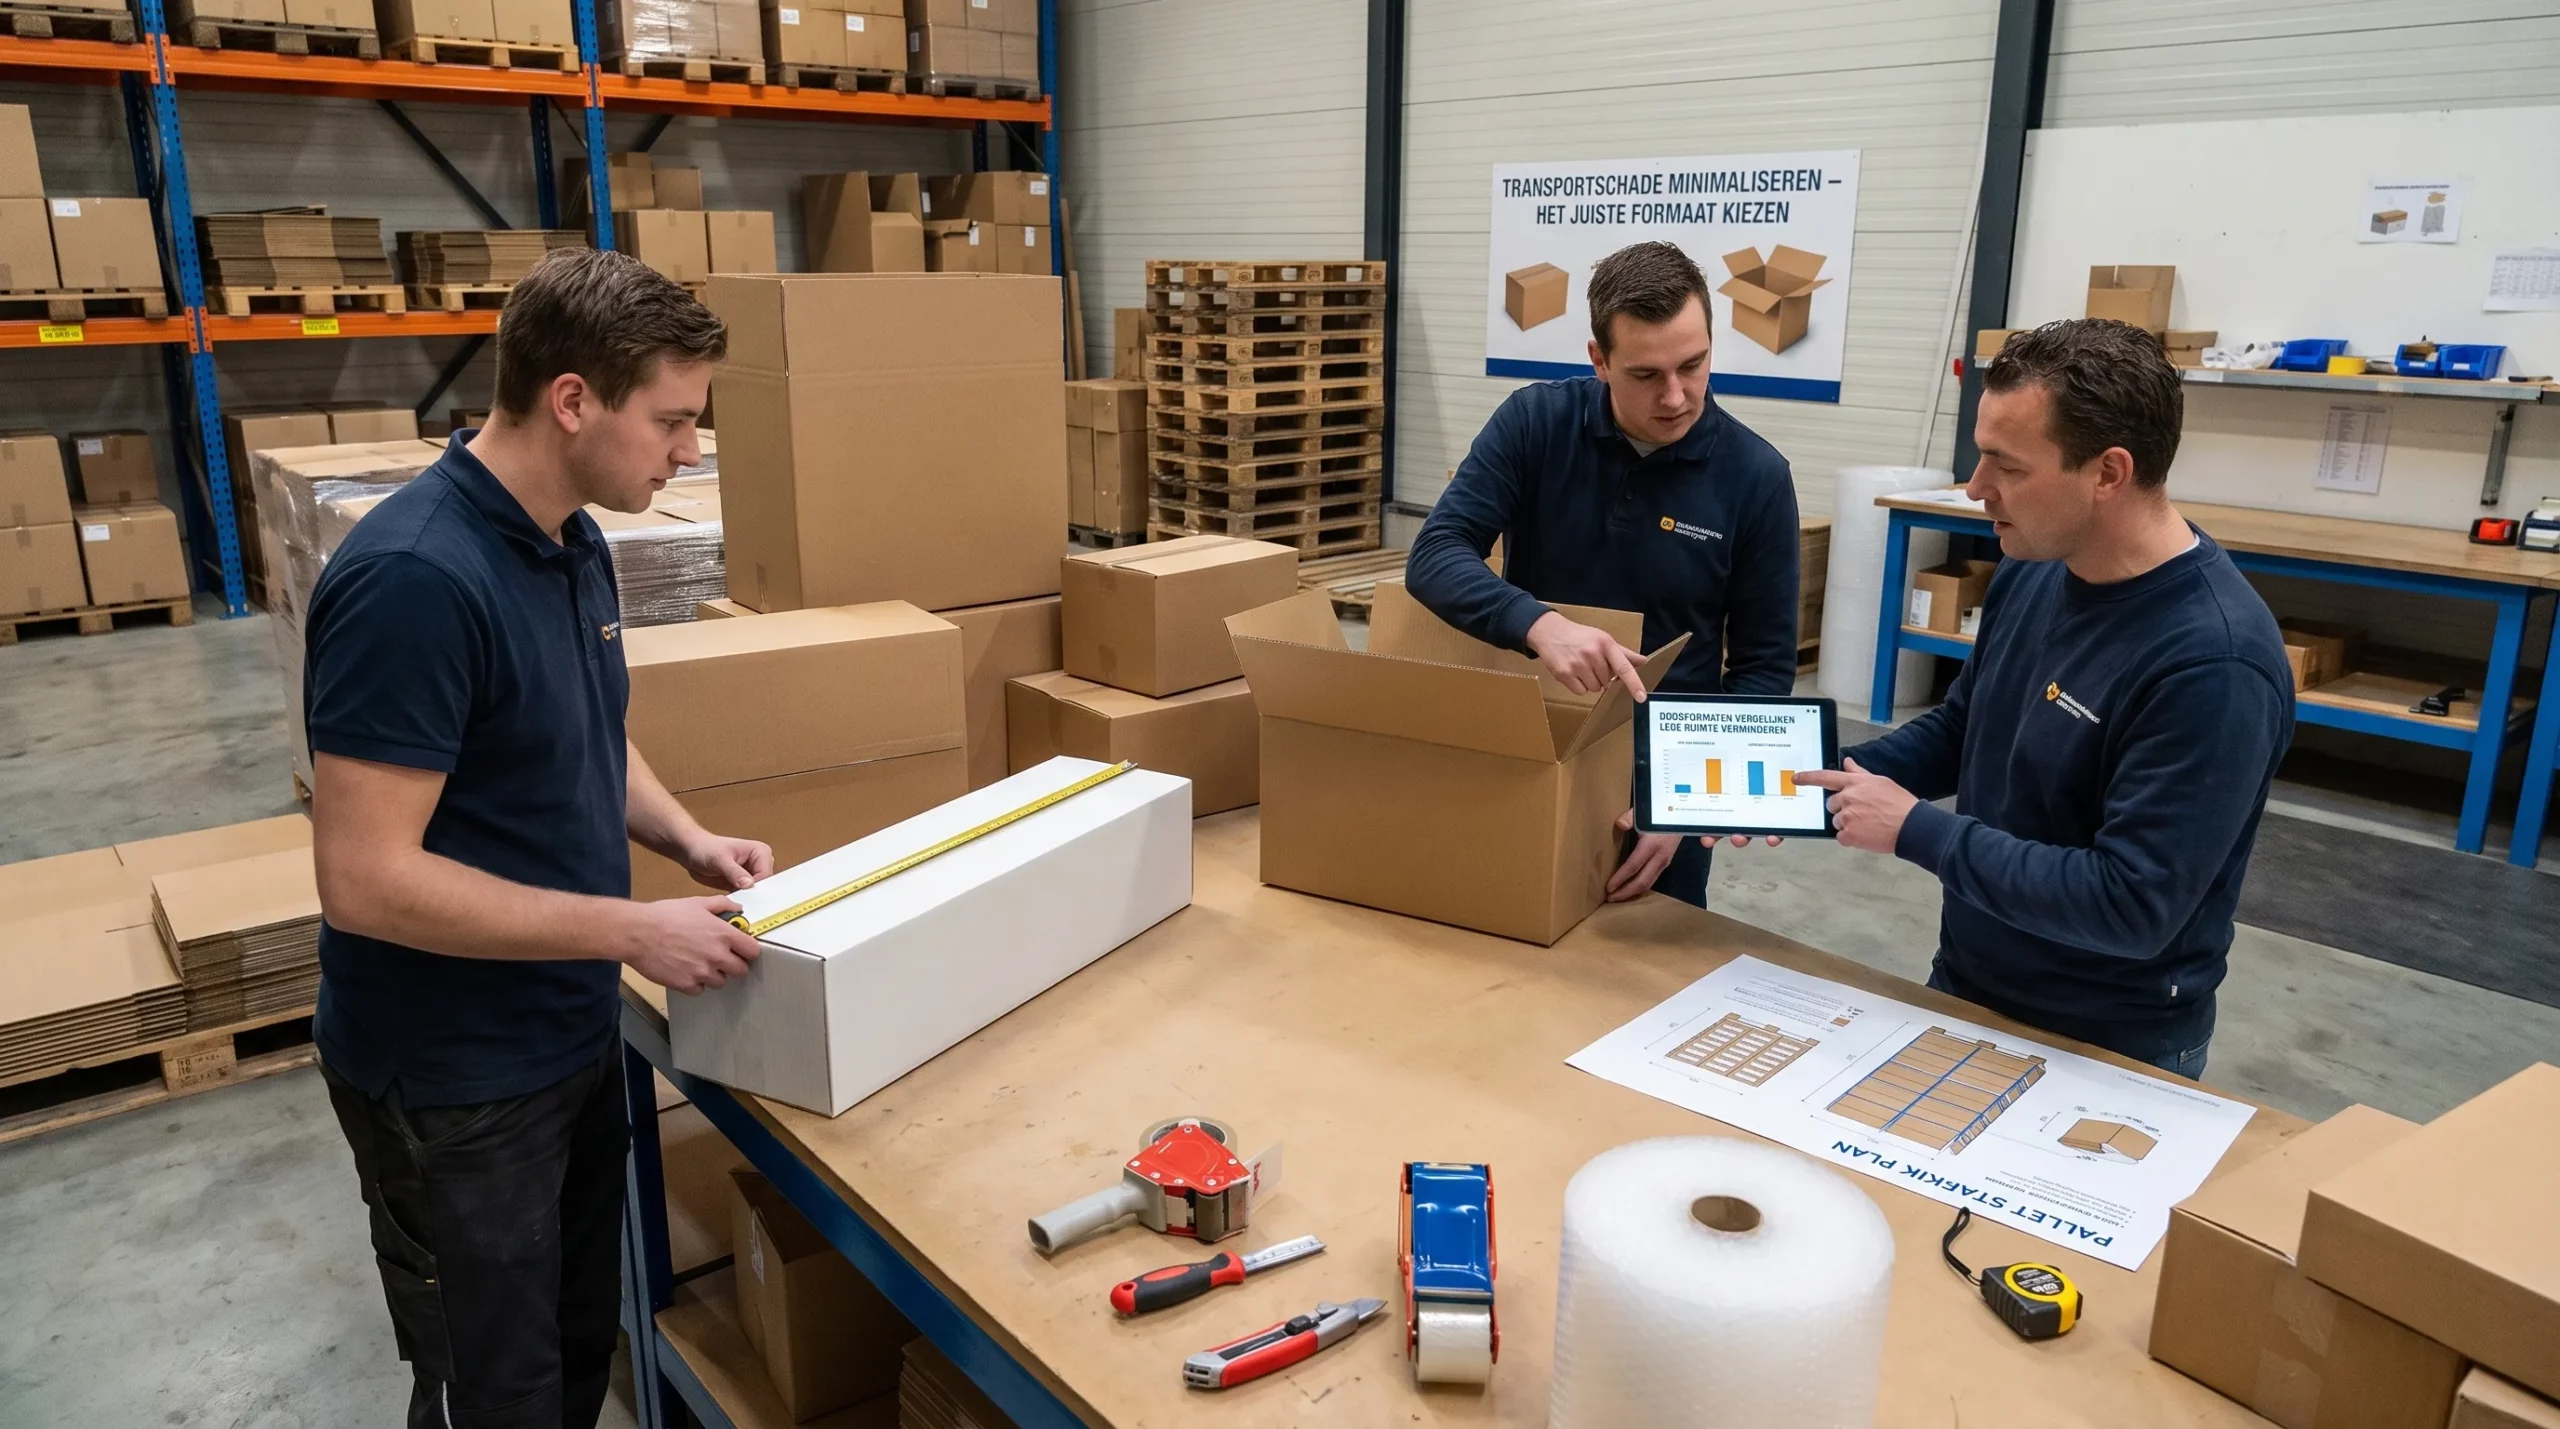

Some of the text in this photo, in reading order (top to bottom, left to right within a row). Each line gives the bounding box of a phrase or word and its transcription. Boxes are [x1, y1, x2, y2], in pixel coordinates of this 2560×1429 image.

[1503, 174, 1662, 197] TRANSPORTSCHADE
[1669, 170, 1821, 193] MINIMALISEREN
[1537, 202, 1789, 224] HET JUISTE FORMAAT KIEZEN
[1659, 712, 1795, 724] DOOSFORMATEN VERGELIJKEN
[1684, 724, 1719, 733] RUIMTE
[1721, 725, 1787, 735] VERMINDEREN
[1831, 1140, 1897, 1170] PLAN
[2010, 1208, 2114, 1248] PALLET
